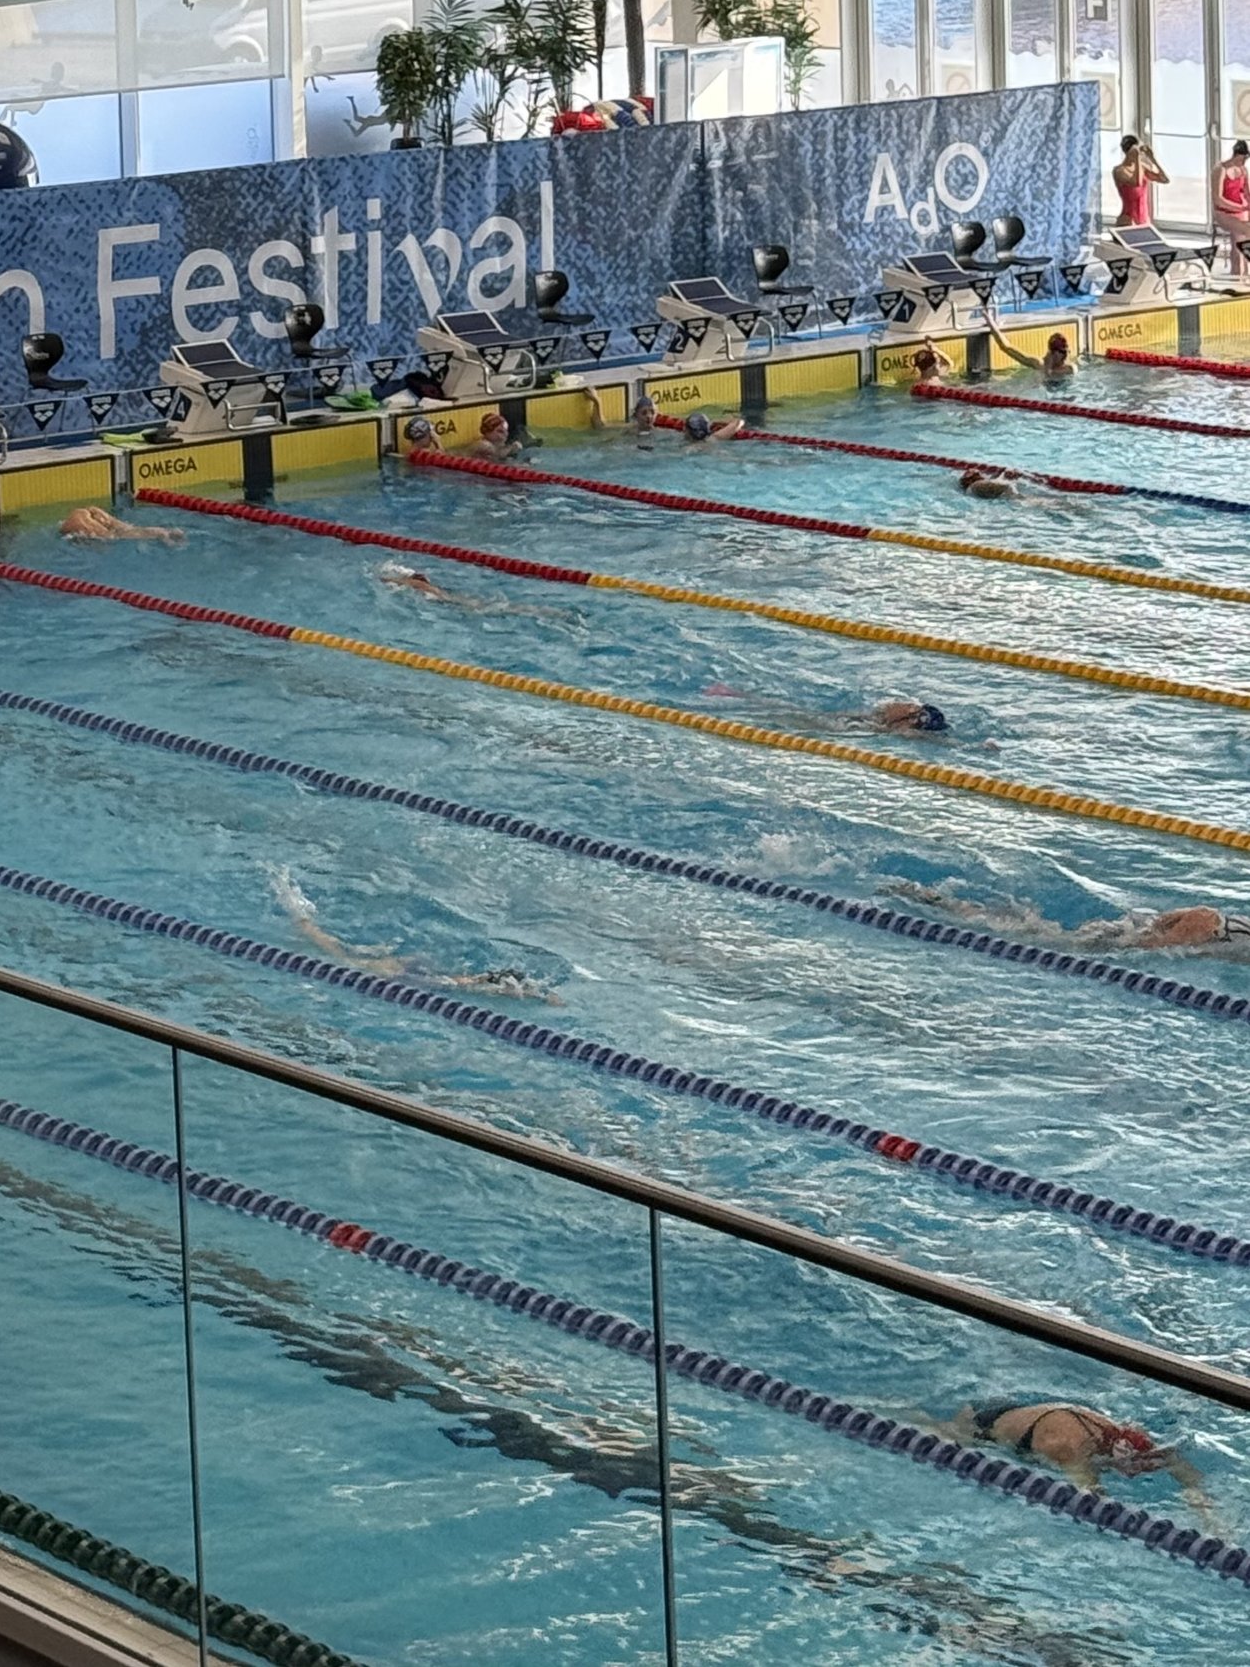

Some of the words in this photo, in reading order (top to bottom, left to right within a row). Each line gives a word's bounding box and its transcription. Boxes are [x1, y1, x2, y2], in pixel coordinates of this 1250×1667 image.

[863, 142, 989, 234] AdO
[97, 181, 553, 359] Festival
[1098, 323, 1142, 341] OMEGA
[675, 333, 684, 351] 2
[881, 355, 915, 372] OME
[651, 386, 700, 404] OMEGA
[138, 456, 197, 479] OMEGA
